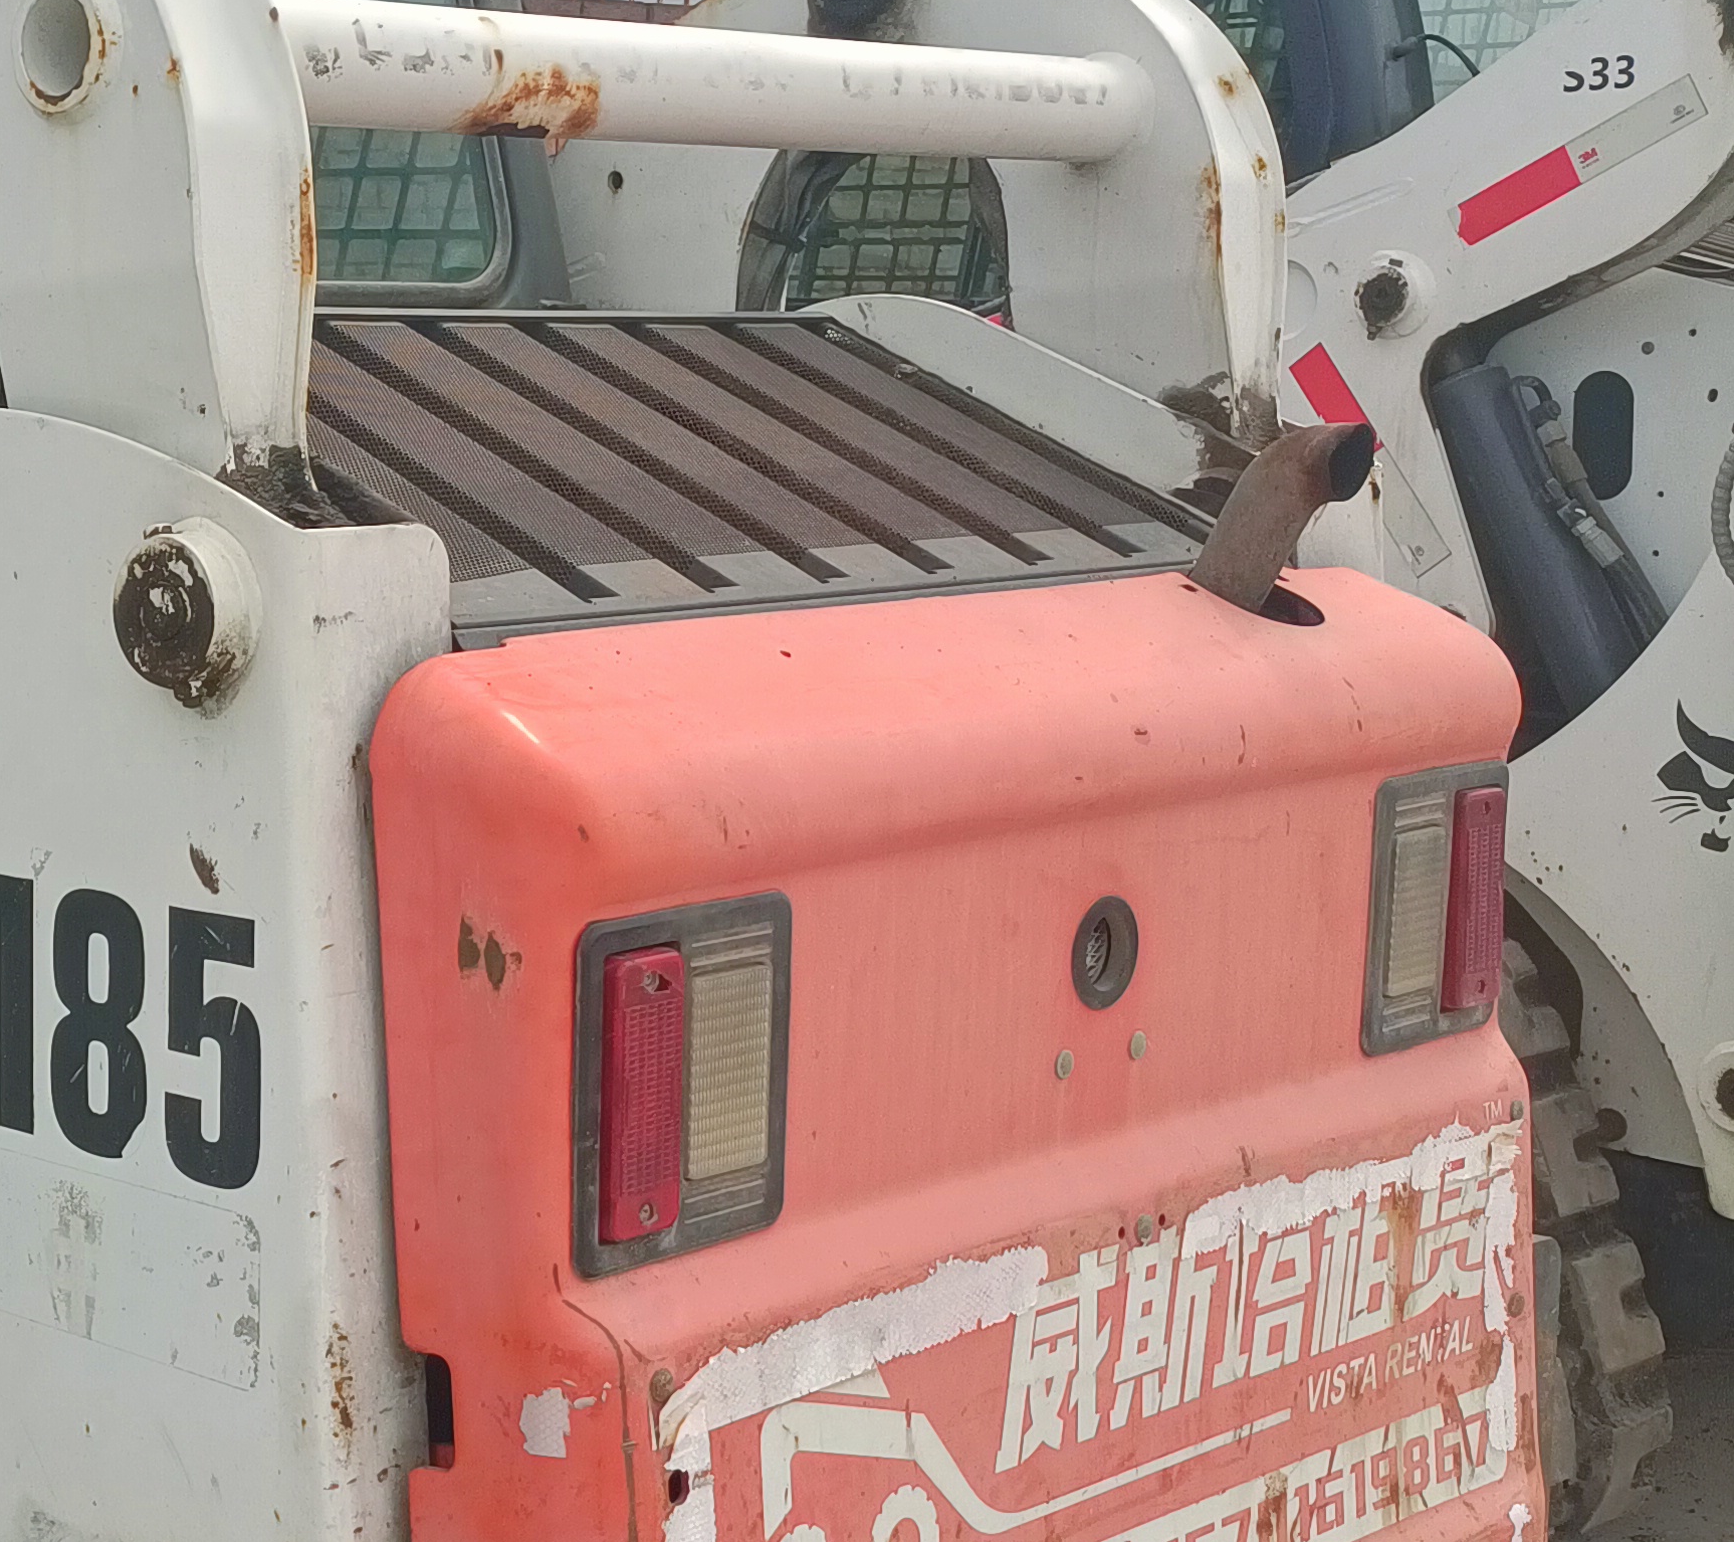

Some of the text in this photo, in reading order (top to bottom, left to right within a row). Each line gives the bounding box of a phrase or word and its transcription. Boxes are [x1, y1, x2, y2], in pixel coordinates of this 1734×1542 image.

[1482, 1098, 1504, 1123] TM
[994, 1151, 1490, 1474] 威斯塔租赁
[1307, 1315, 1474, 1413] VISTA RENTAL
